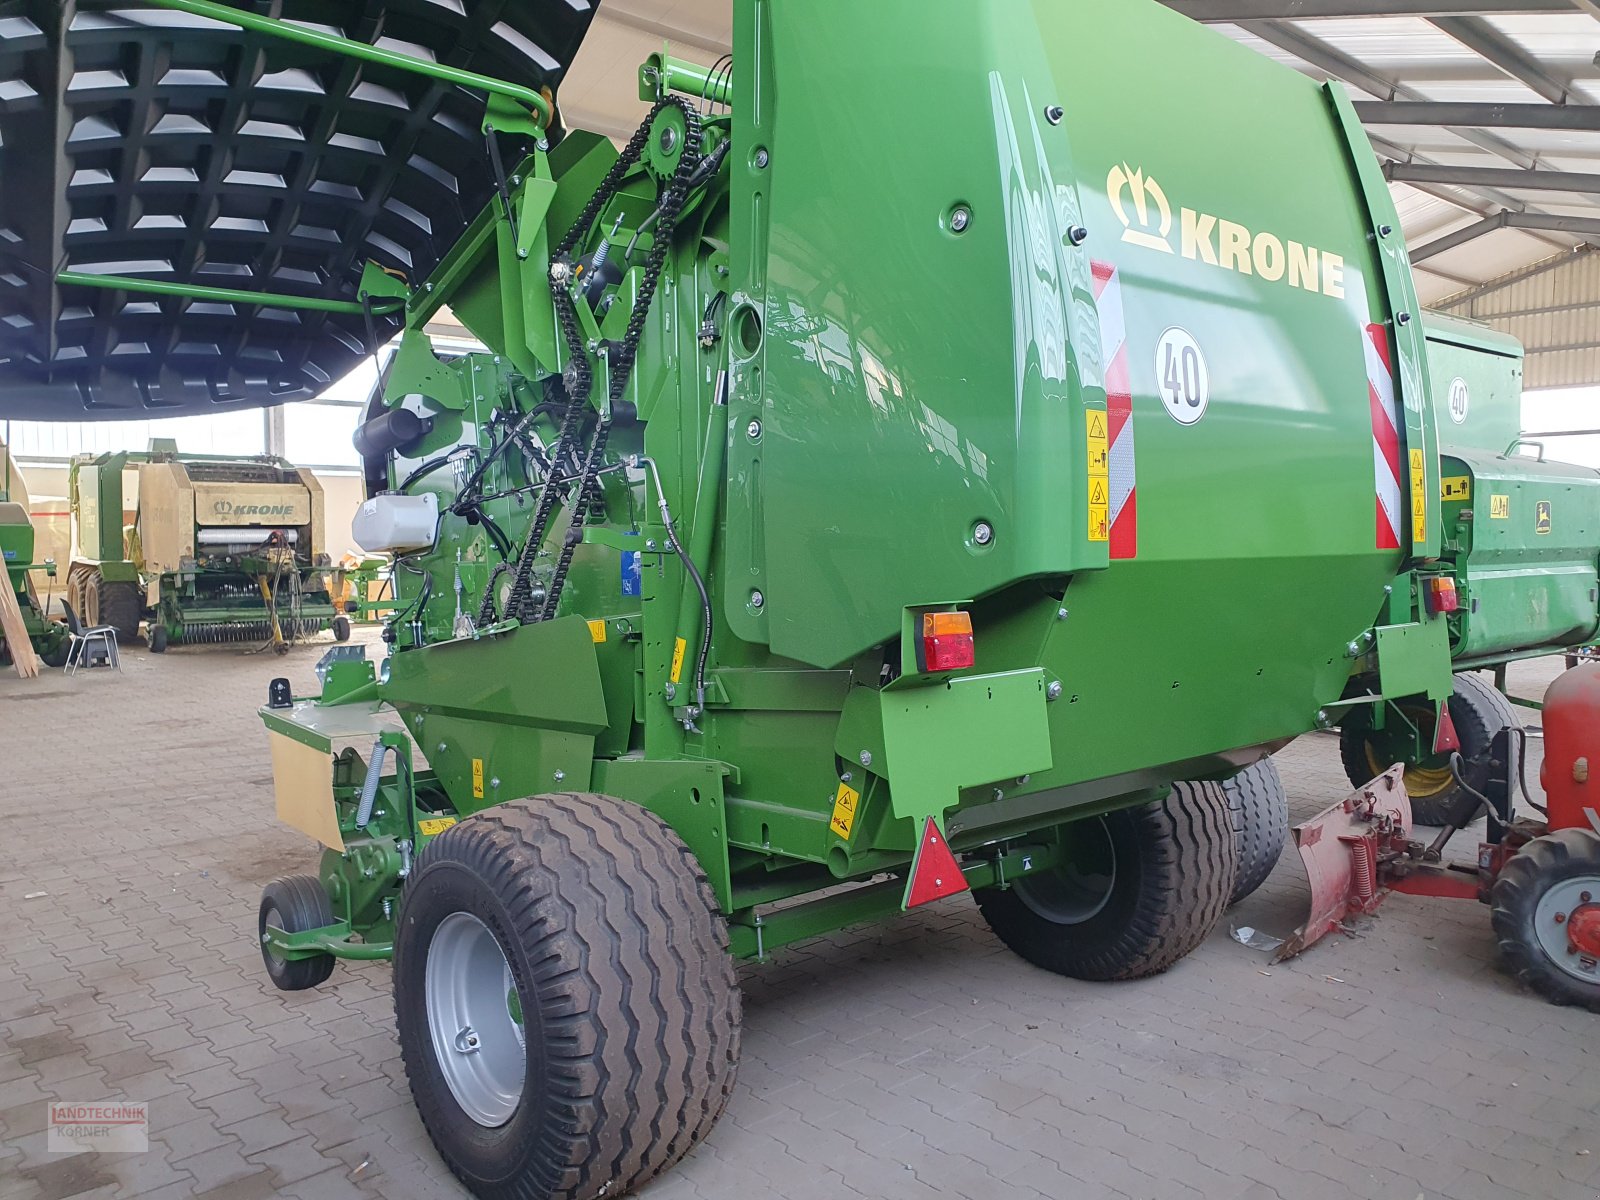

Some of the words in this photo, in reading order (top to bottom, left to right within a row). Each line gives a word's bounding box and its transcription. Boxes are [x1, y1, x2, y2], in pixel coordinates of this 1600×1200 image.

[1180, 207, 1344, 299] KRONE
[1163, 342, 1201, 408] 40
[1452, 385, 1465, 415] 40
[233, 505, 294, 515] KRONE
